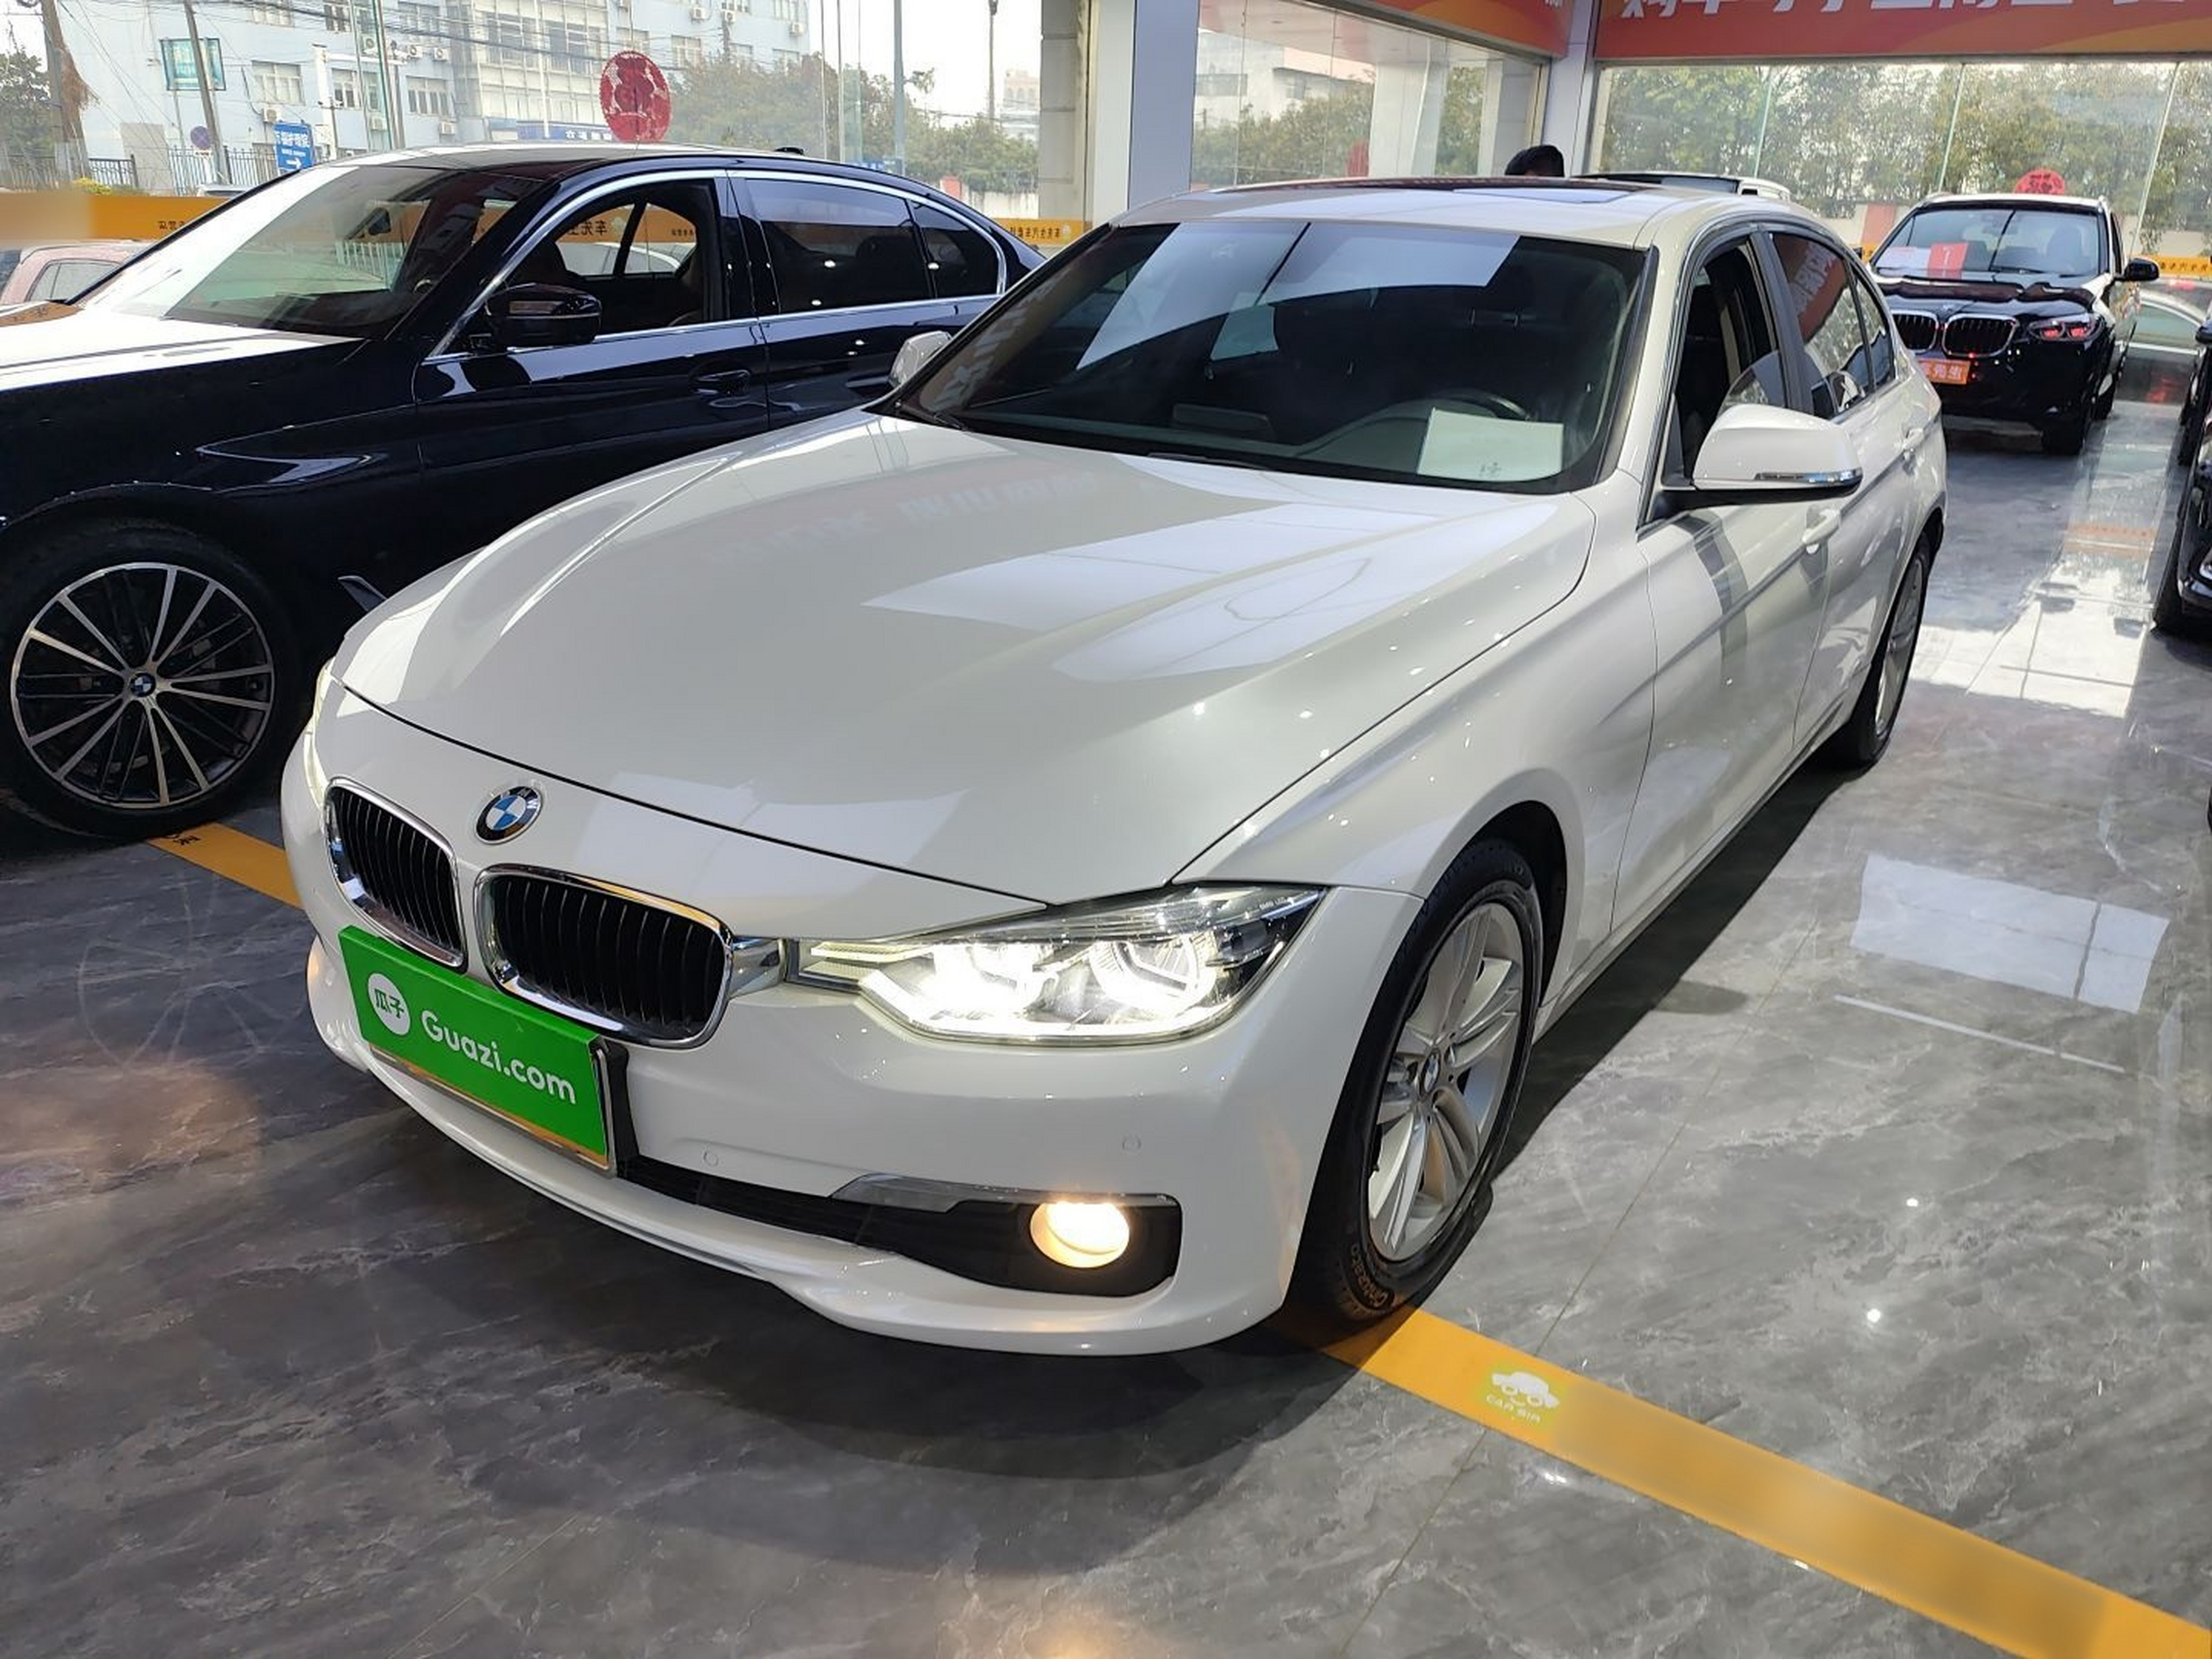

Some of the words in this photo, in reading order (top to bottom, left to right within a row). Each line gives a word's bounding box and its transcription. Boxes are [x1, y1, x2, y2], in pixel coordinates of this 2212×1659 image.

[374, 988, 404, 1019] 瓜子
[422, 1009, 576, 1104] Guazi.com
[1486, 1394, 1514, 1414] CAR
